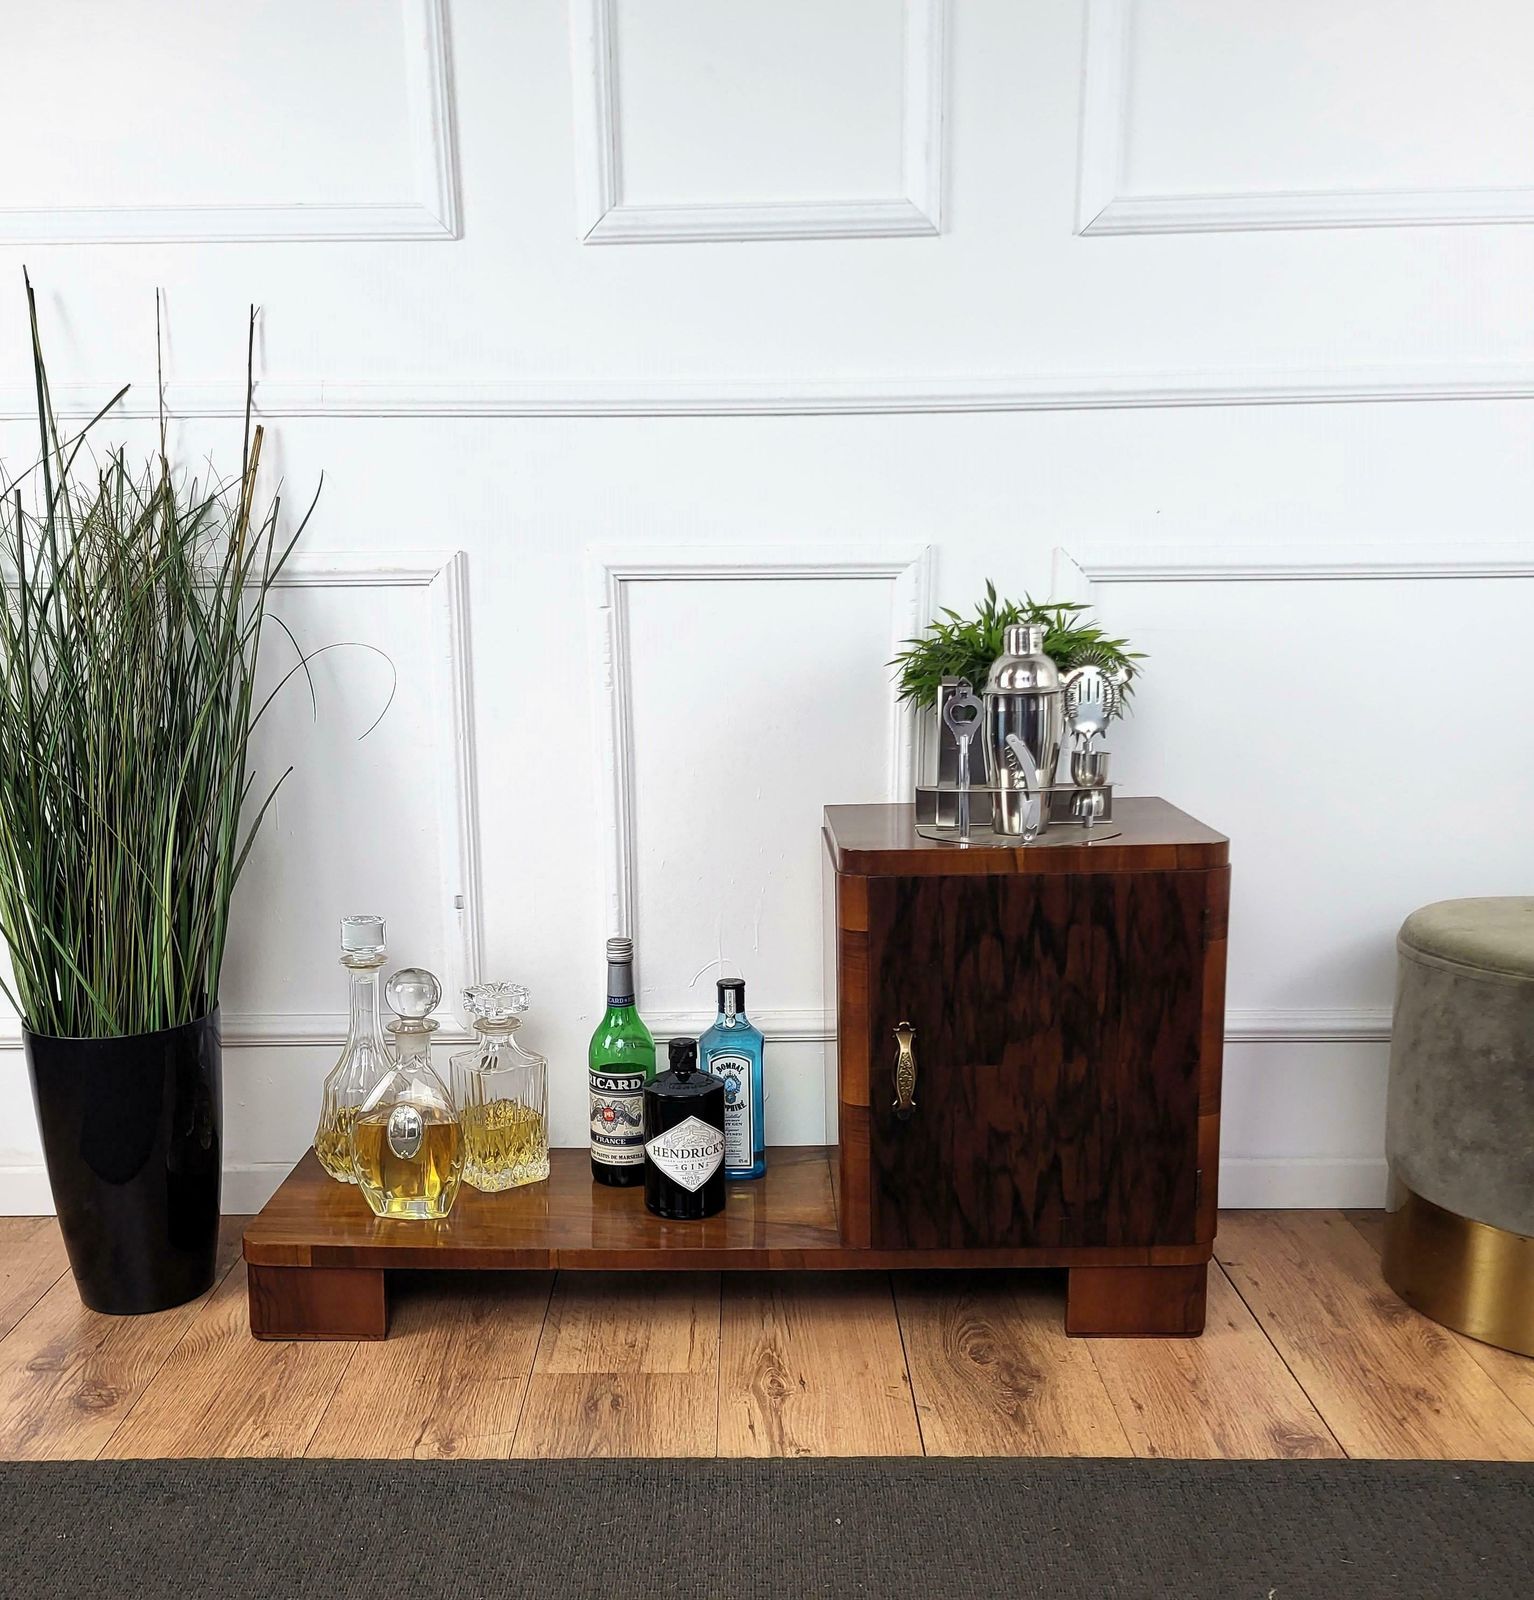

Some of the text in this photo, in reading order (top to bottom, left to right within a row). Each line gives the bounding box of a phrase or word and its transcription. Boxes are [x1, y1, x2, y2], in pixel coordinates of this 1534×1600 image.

[715, 1062, 745, 1075] BOMBAY
[725, 1099, 747, 1112] PHIRE
[595, 1135, 627, 1145] FRANCE
[653, 1139, 725, 1159] HENDRICK'S
[680, 1161, 705, 1171] GIN
